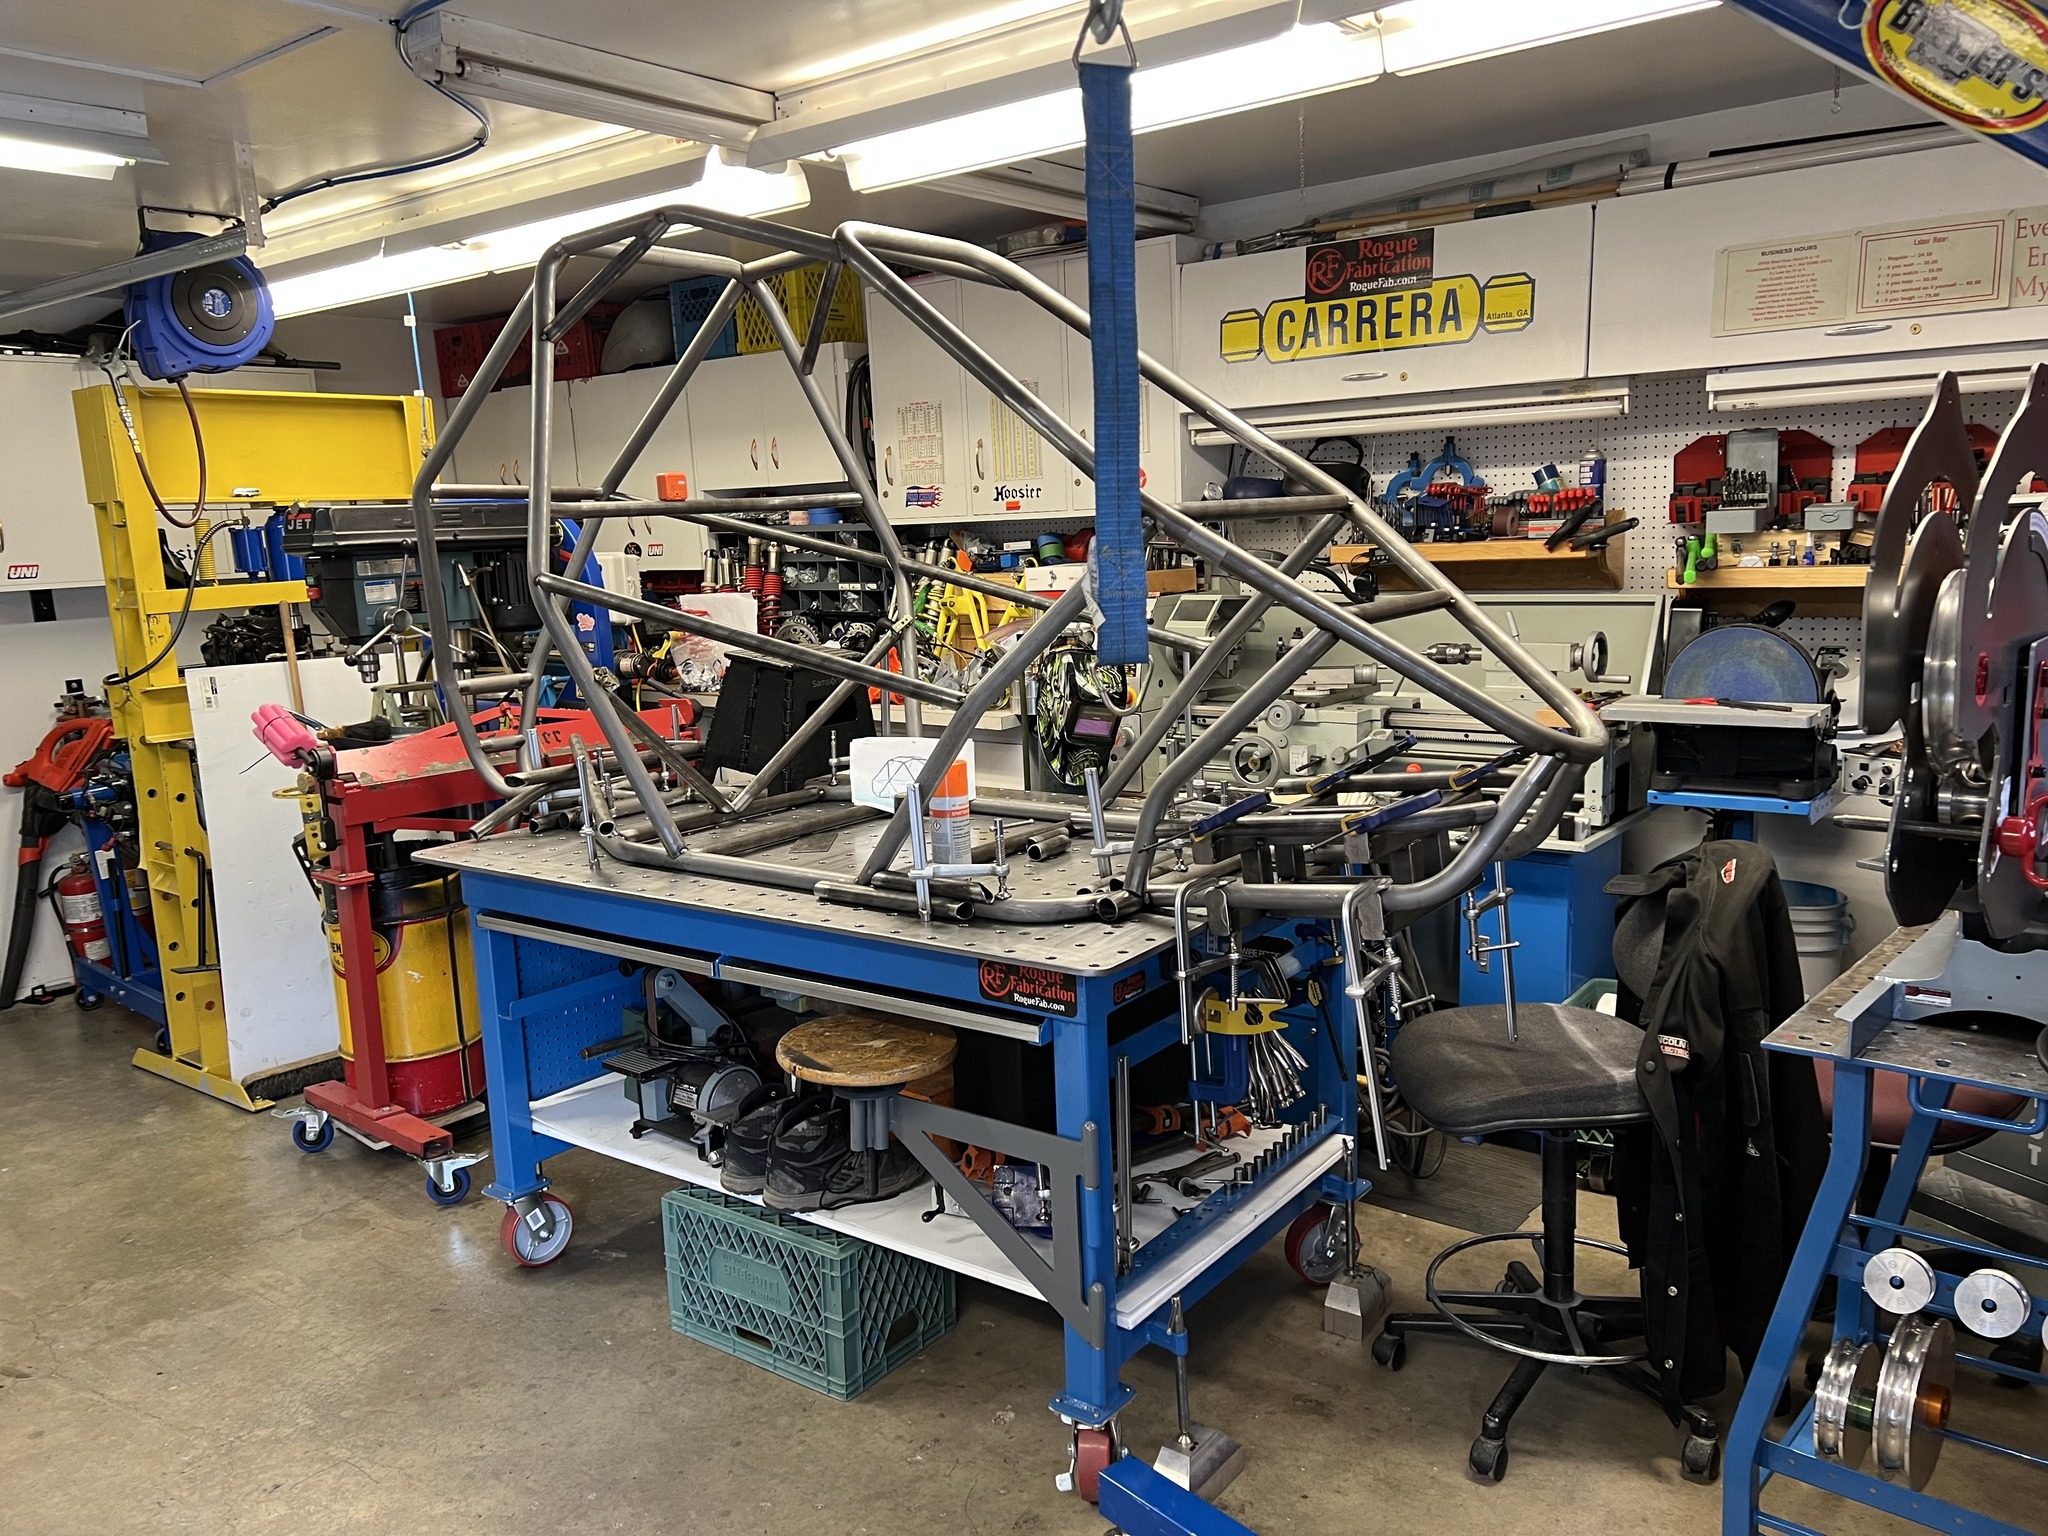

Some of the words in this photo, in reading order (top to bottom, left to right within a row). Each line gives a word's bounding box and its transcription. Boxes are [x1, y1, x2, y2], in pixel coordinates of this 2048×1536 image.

[1358, 236, 1418, 259] Rogue
[1913, 238, 1930, 246] Labor
[1761, 247, 1792, 257] BUSINESS
[1794, 244, 1818, 253] HOURS
[1346, 253, 1432, 279] Fabrication
[1349, 276, 1417, 292] RogueFab.com
[1276, 287, 1463, 352] CARRERA
[1486, 309, 1515, 321] Atlanta,
[1516, 308, 1529, 318] GA
[993, 485, 1041, 501] Hoosier
[287, 519, 312, 530] JET
[649, 546, 663, 556] UNI
[9, 567, 38, 579] UNI
[1018, 965, 1064, 985] Rogue
[1009, 976, 1076, 1003] Fabrication
[1013, 993, 1066, 1012] RogueFab.com
